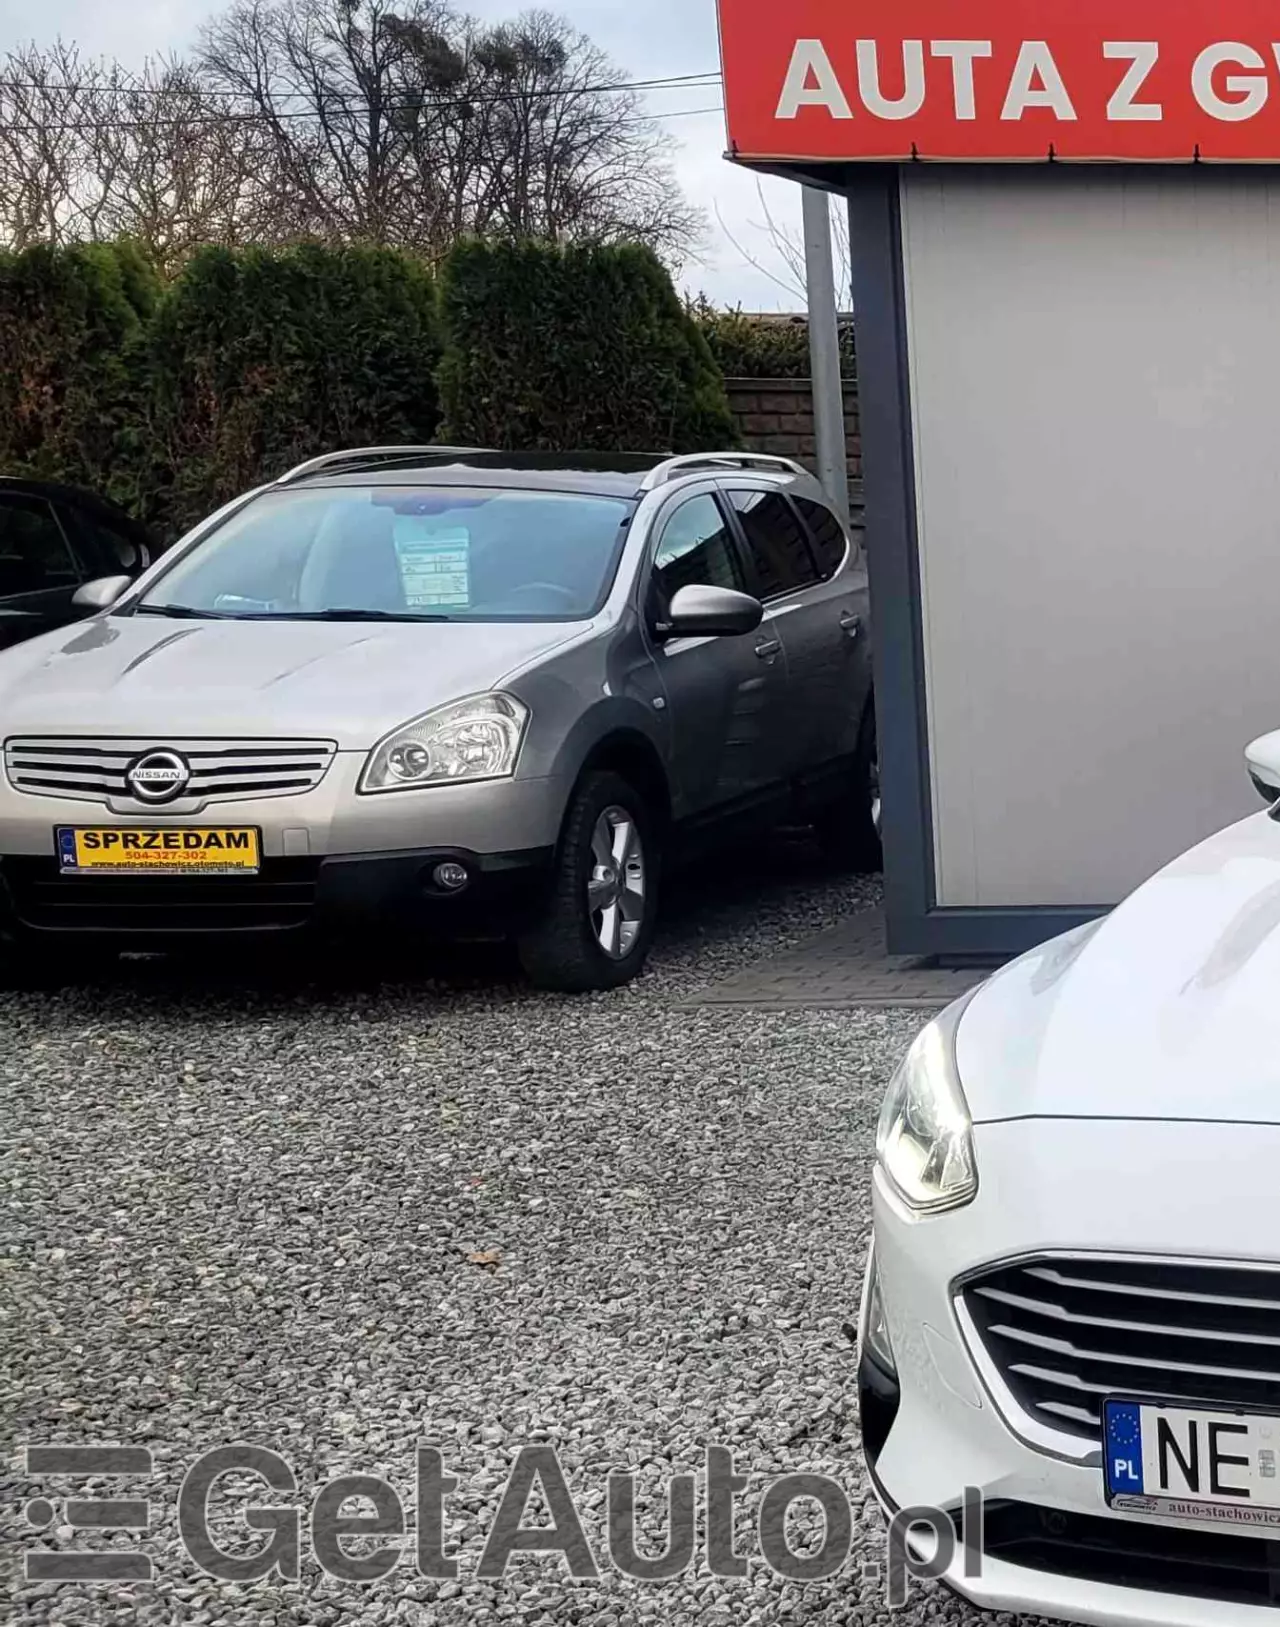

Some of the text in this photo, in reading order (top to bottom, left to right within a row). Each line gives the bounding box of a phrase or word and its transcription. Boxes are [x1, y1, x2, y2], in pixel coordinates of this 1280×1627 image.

[775, 39, 1078, 121] AUTA
[1102, 41, 1163, 121] Z
[132, 771, 180, 779] NISSAN
[83, 832, 249, 849] SPRZEDAM
[63, 854, 76, 864] PL
[124, 851, 208, 860] 504-327-302
[1157, 1416, 1250, 1499] NE
[1114, 1458, 1139, 1480] PL
